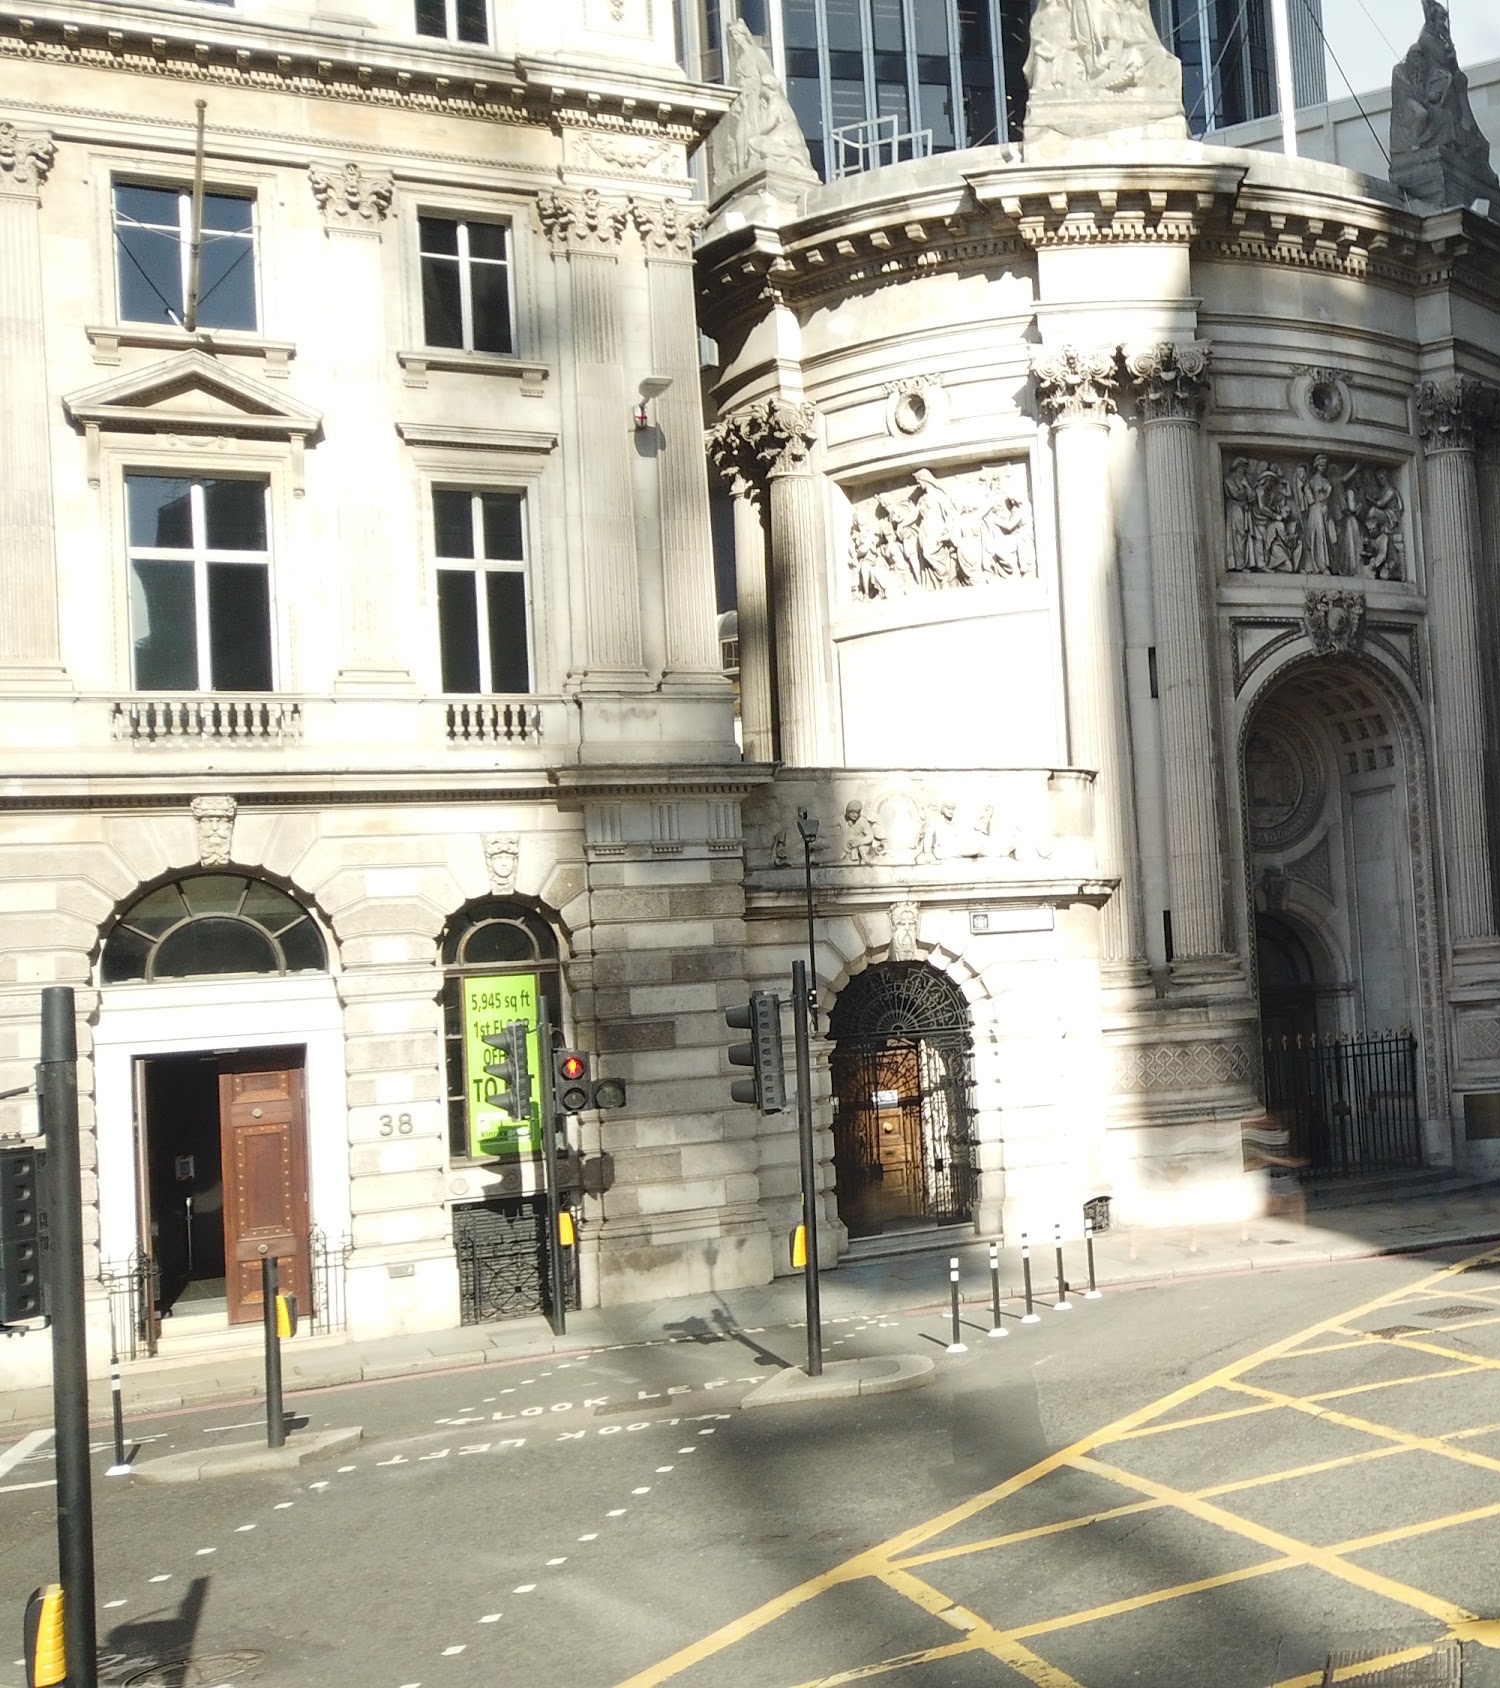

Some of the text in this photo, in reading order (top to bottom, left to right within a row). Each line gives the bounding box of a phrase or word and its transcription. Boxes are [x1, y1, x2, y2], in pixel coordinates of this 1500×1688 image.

[471, 989, 530, 1013] 5,945 sq ft
[474, 1017, 530, 1038] 1st FLR
[473, 1077, 498, 1103] TO
[379, 1112, 414, 1137] 38
[491, 1376, 767, 1421] LOOK LEFT
[376, 1417, 681, 1467] LOOK LEFT
